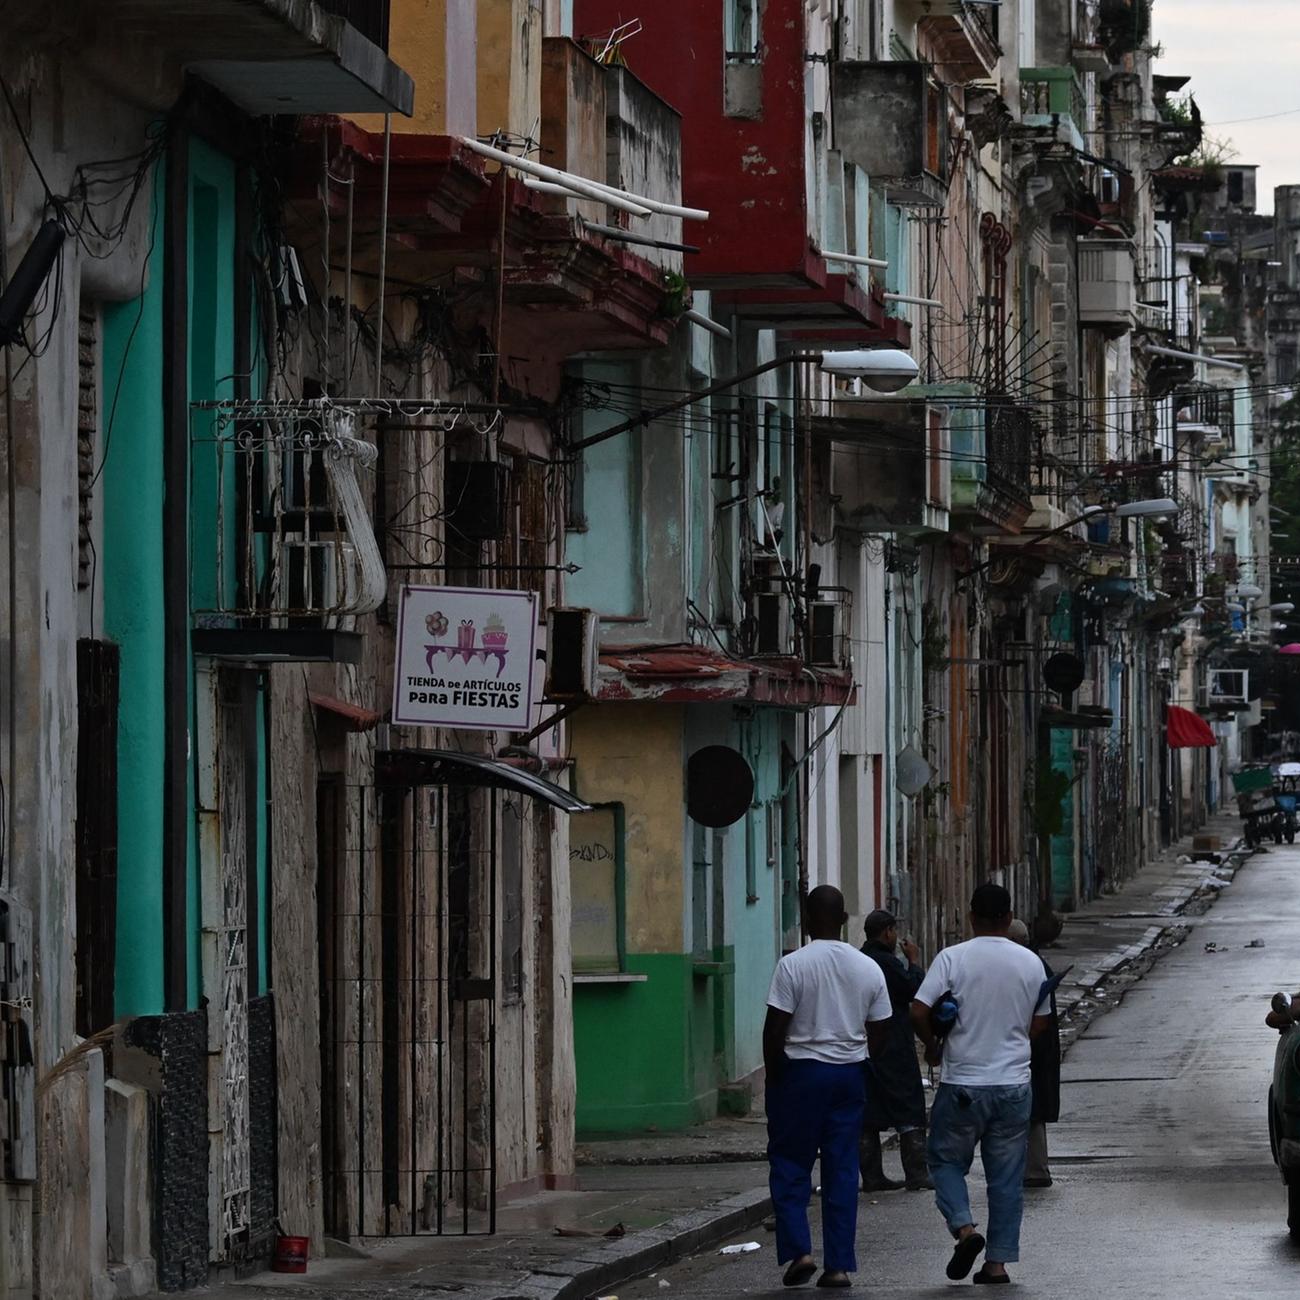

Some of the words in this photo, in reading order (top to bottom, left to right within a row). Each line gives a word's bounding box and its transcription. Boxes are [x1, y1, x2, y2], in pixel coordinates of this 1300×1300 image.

[407, 676, 445, 688] TIENDA
[462, 679, 521, 692] ARTÍCULOS
[452, 690, 520, 709] FIESTAS
